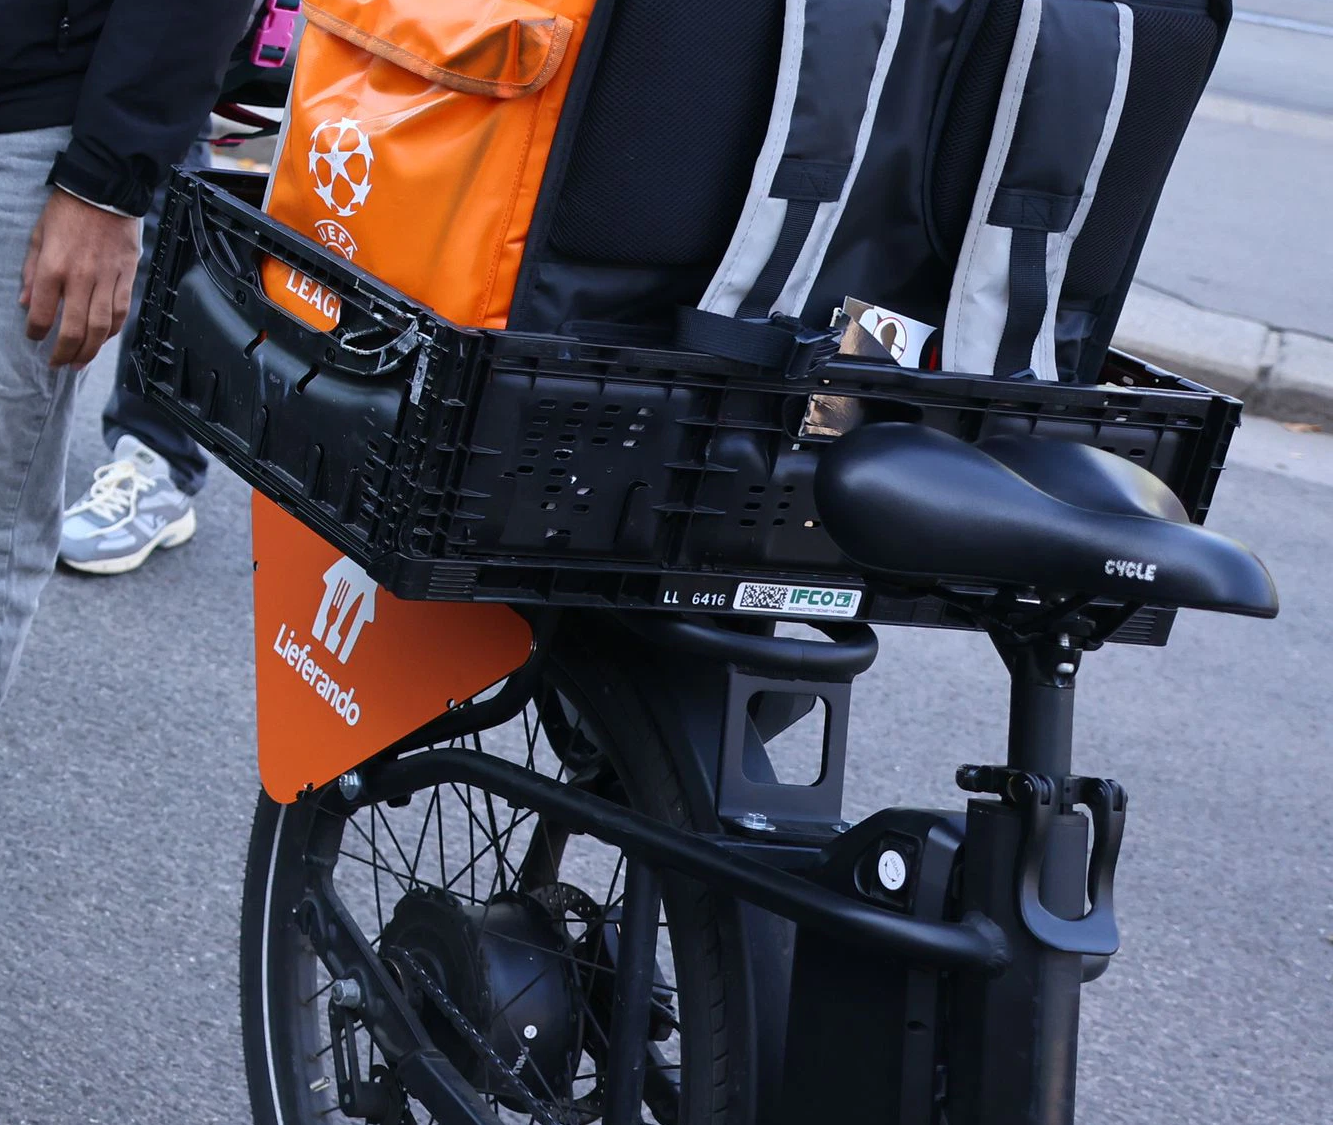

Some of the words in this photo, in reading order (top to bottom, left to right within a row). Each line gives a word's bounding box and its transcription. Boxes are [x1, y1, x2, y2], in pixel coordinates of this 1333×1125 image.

[317, 225, 354, 261] UEFA
[1104, 559, 1157, 582] CYCLE
[663, 590, 680, 604] LL
[692, 592, 726, 606] 6416
[789, 588, 835, 606] IFCO
[273, 623, 360, 726] Lieferando
